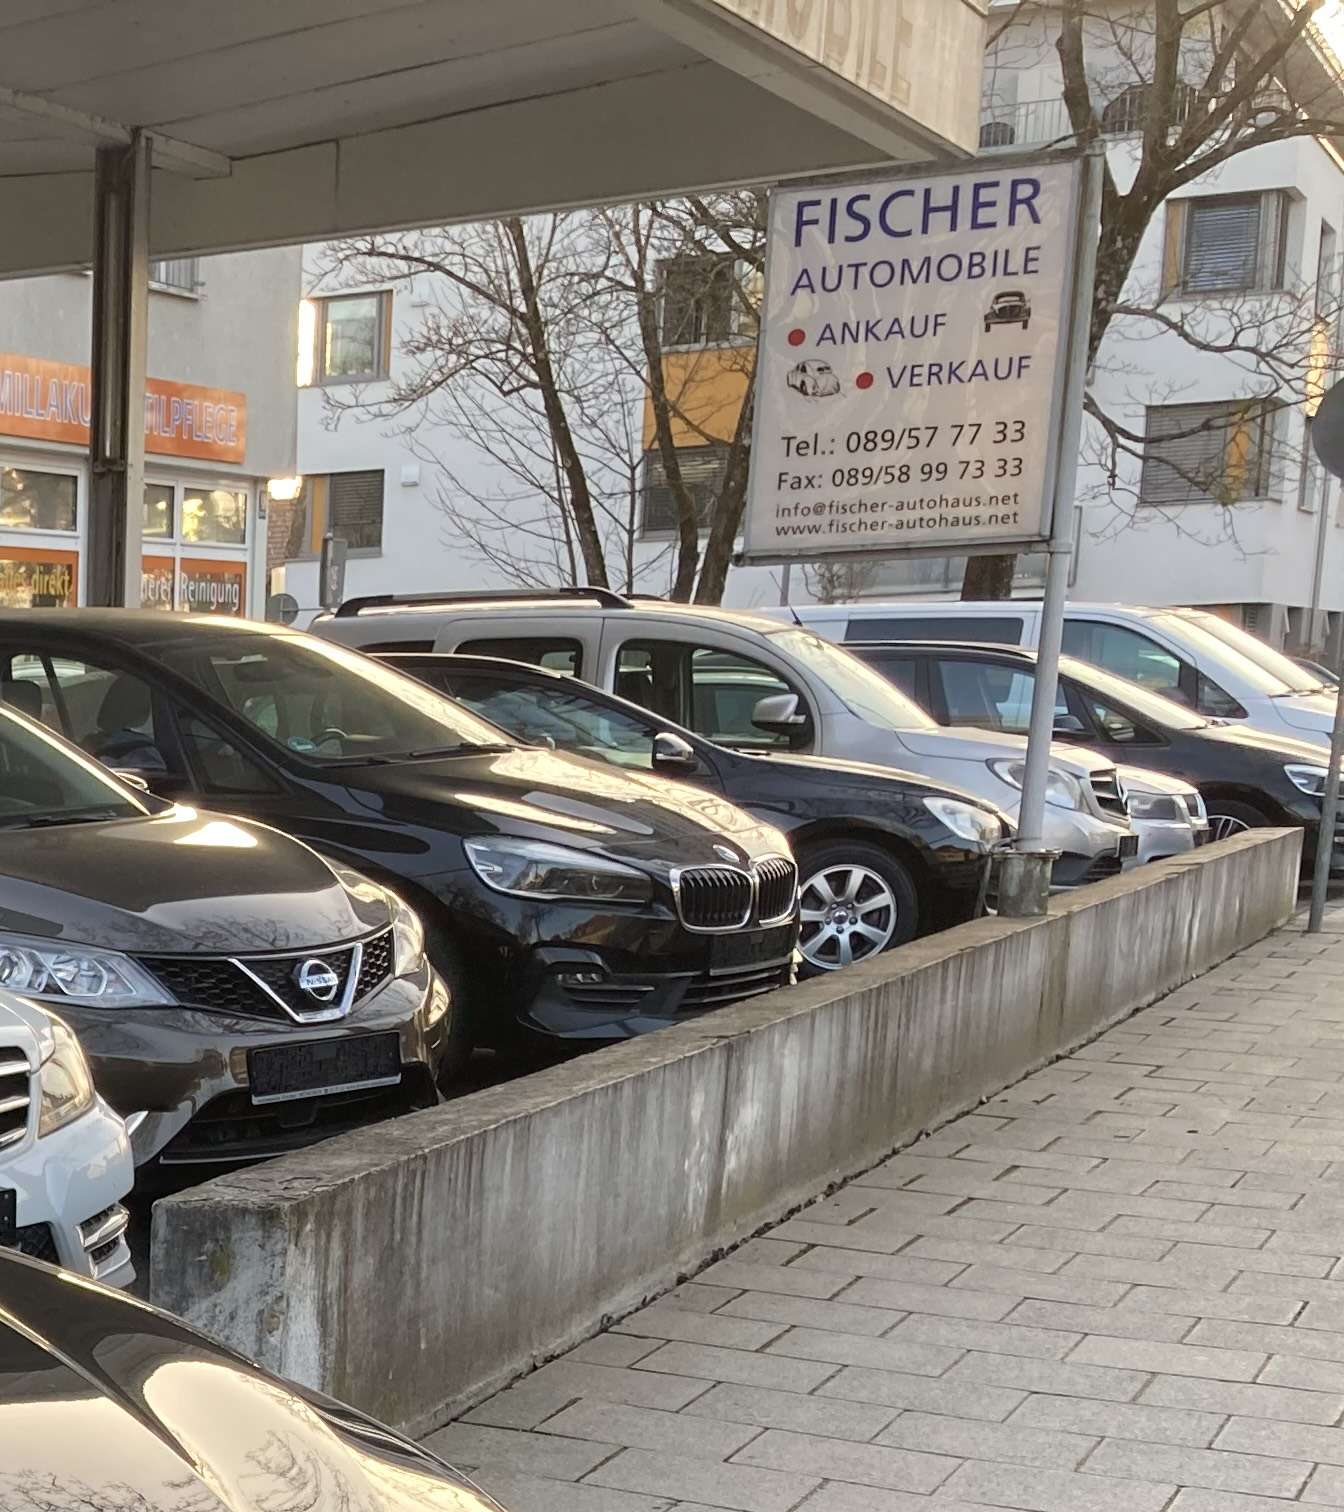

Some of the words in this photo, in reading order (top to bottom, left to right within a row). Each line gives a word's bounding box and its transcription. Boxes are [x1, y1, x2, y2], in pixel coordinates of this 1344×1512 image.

[794, 177, 1042, 248] FISCHER
[791, 246, 1042, 297] AUTOMOBILE
[816, 313, 948, 347] ANKAUF
[886, 355, 1033, 389] VERKAUF
[781, 432, 836, 458] Tel.:
[846, 426, 939, 454] 089/57
[950, 423, 983, 447] 77
[992, 419, 1027, 443] 33
[777, 471, 823, 492] Fax:
[831, 464, 911, 488] 089/58
[921, 461, 949, 483] 99
[958, 459, 985, 480] 73
[994, 457, 1024, 478] 33
[775, 491, 1020, 519] info@fischer-autohaus.net
[775, 511, 1019, 537] www.fischer-autohaus.net
[180, 572, 240, 611] Reinigung
